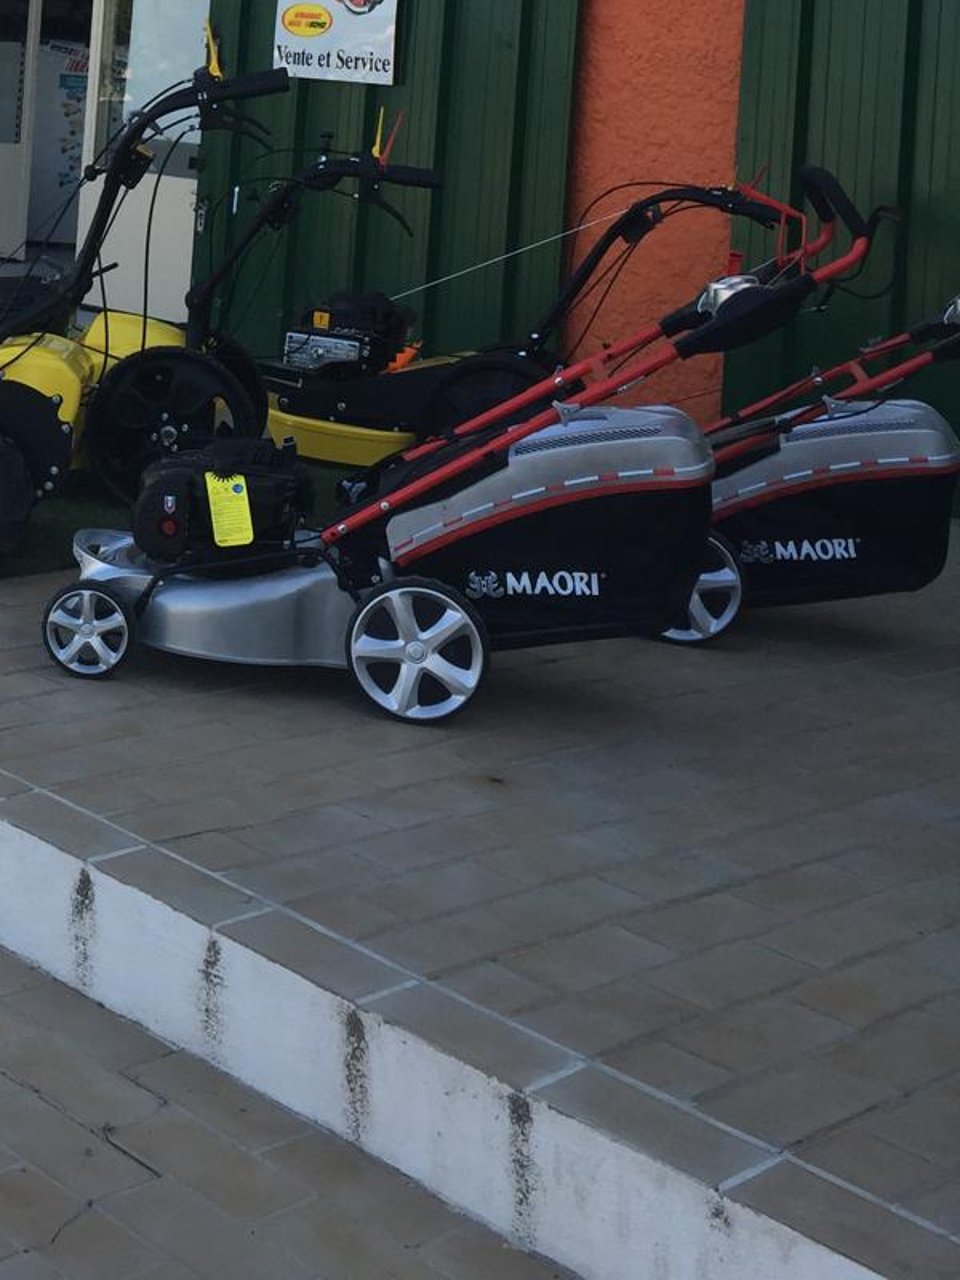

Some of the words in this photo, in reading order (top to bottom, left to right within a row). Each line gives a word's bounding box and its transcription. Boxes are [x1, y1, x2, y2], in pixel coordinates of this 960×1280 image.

[276, 45, 313, 67] Vente
[318, 51, 331, 68] et
[336, 49, 392, 73] Service
[775, 538, 857, 561] MAORI
[506, 570, 600, 597] MAORI
